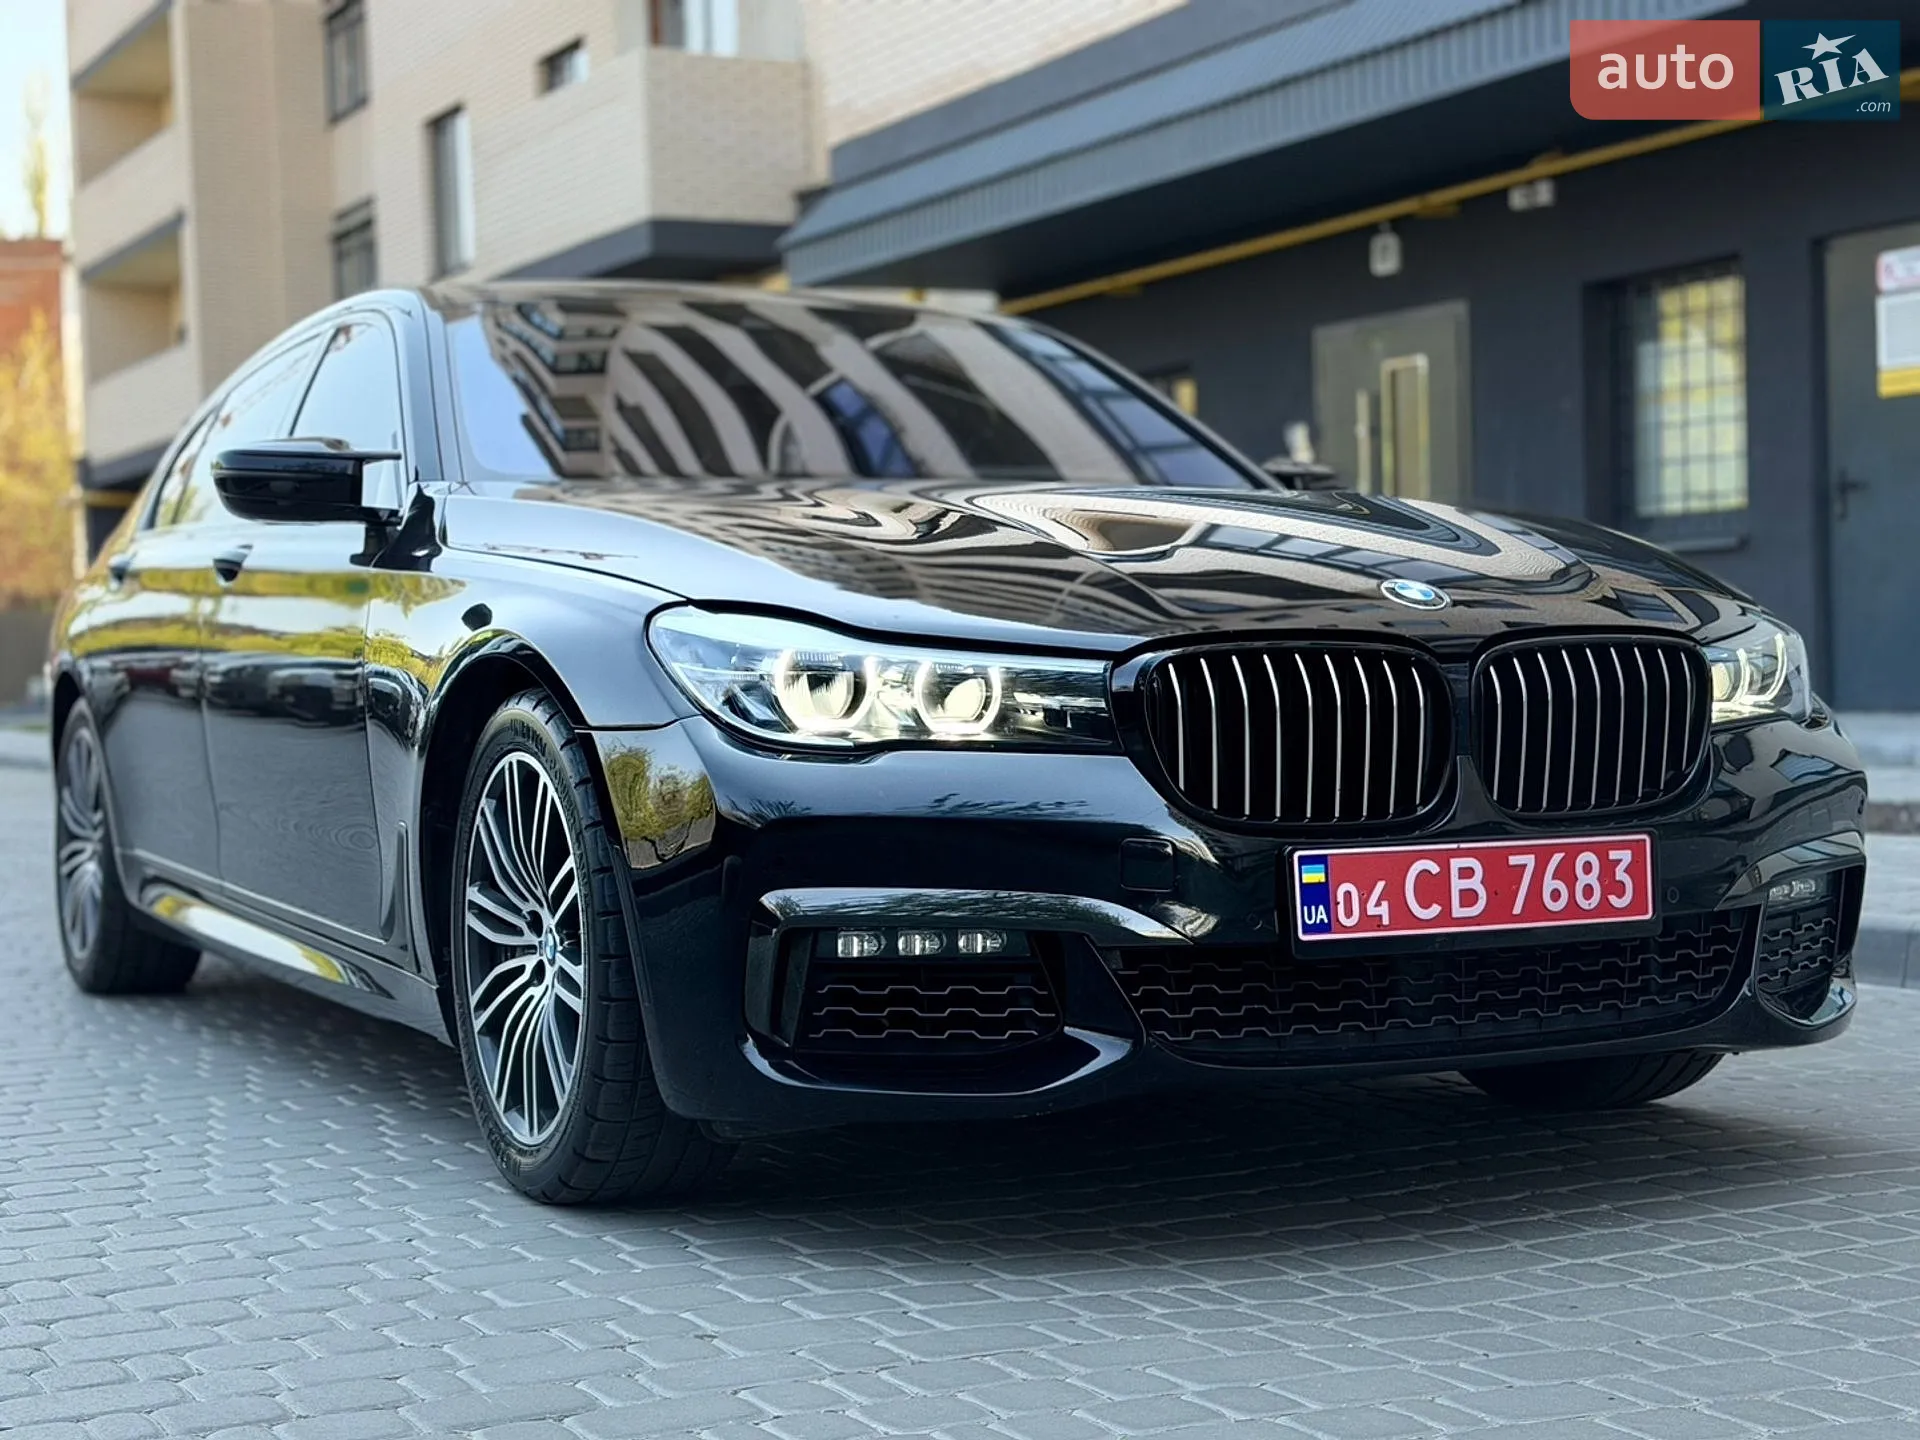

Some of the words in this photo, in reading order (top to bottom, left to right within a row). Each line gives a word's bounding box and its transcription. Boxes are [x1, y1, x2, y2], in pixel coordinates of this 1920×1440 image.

[1336, 879, 1390, 927] 04
[1404, 857, 1488, 920] CB
[1508, 850, 1634, 915] 7683
[1303, 904, 1329, 925] UA
